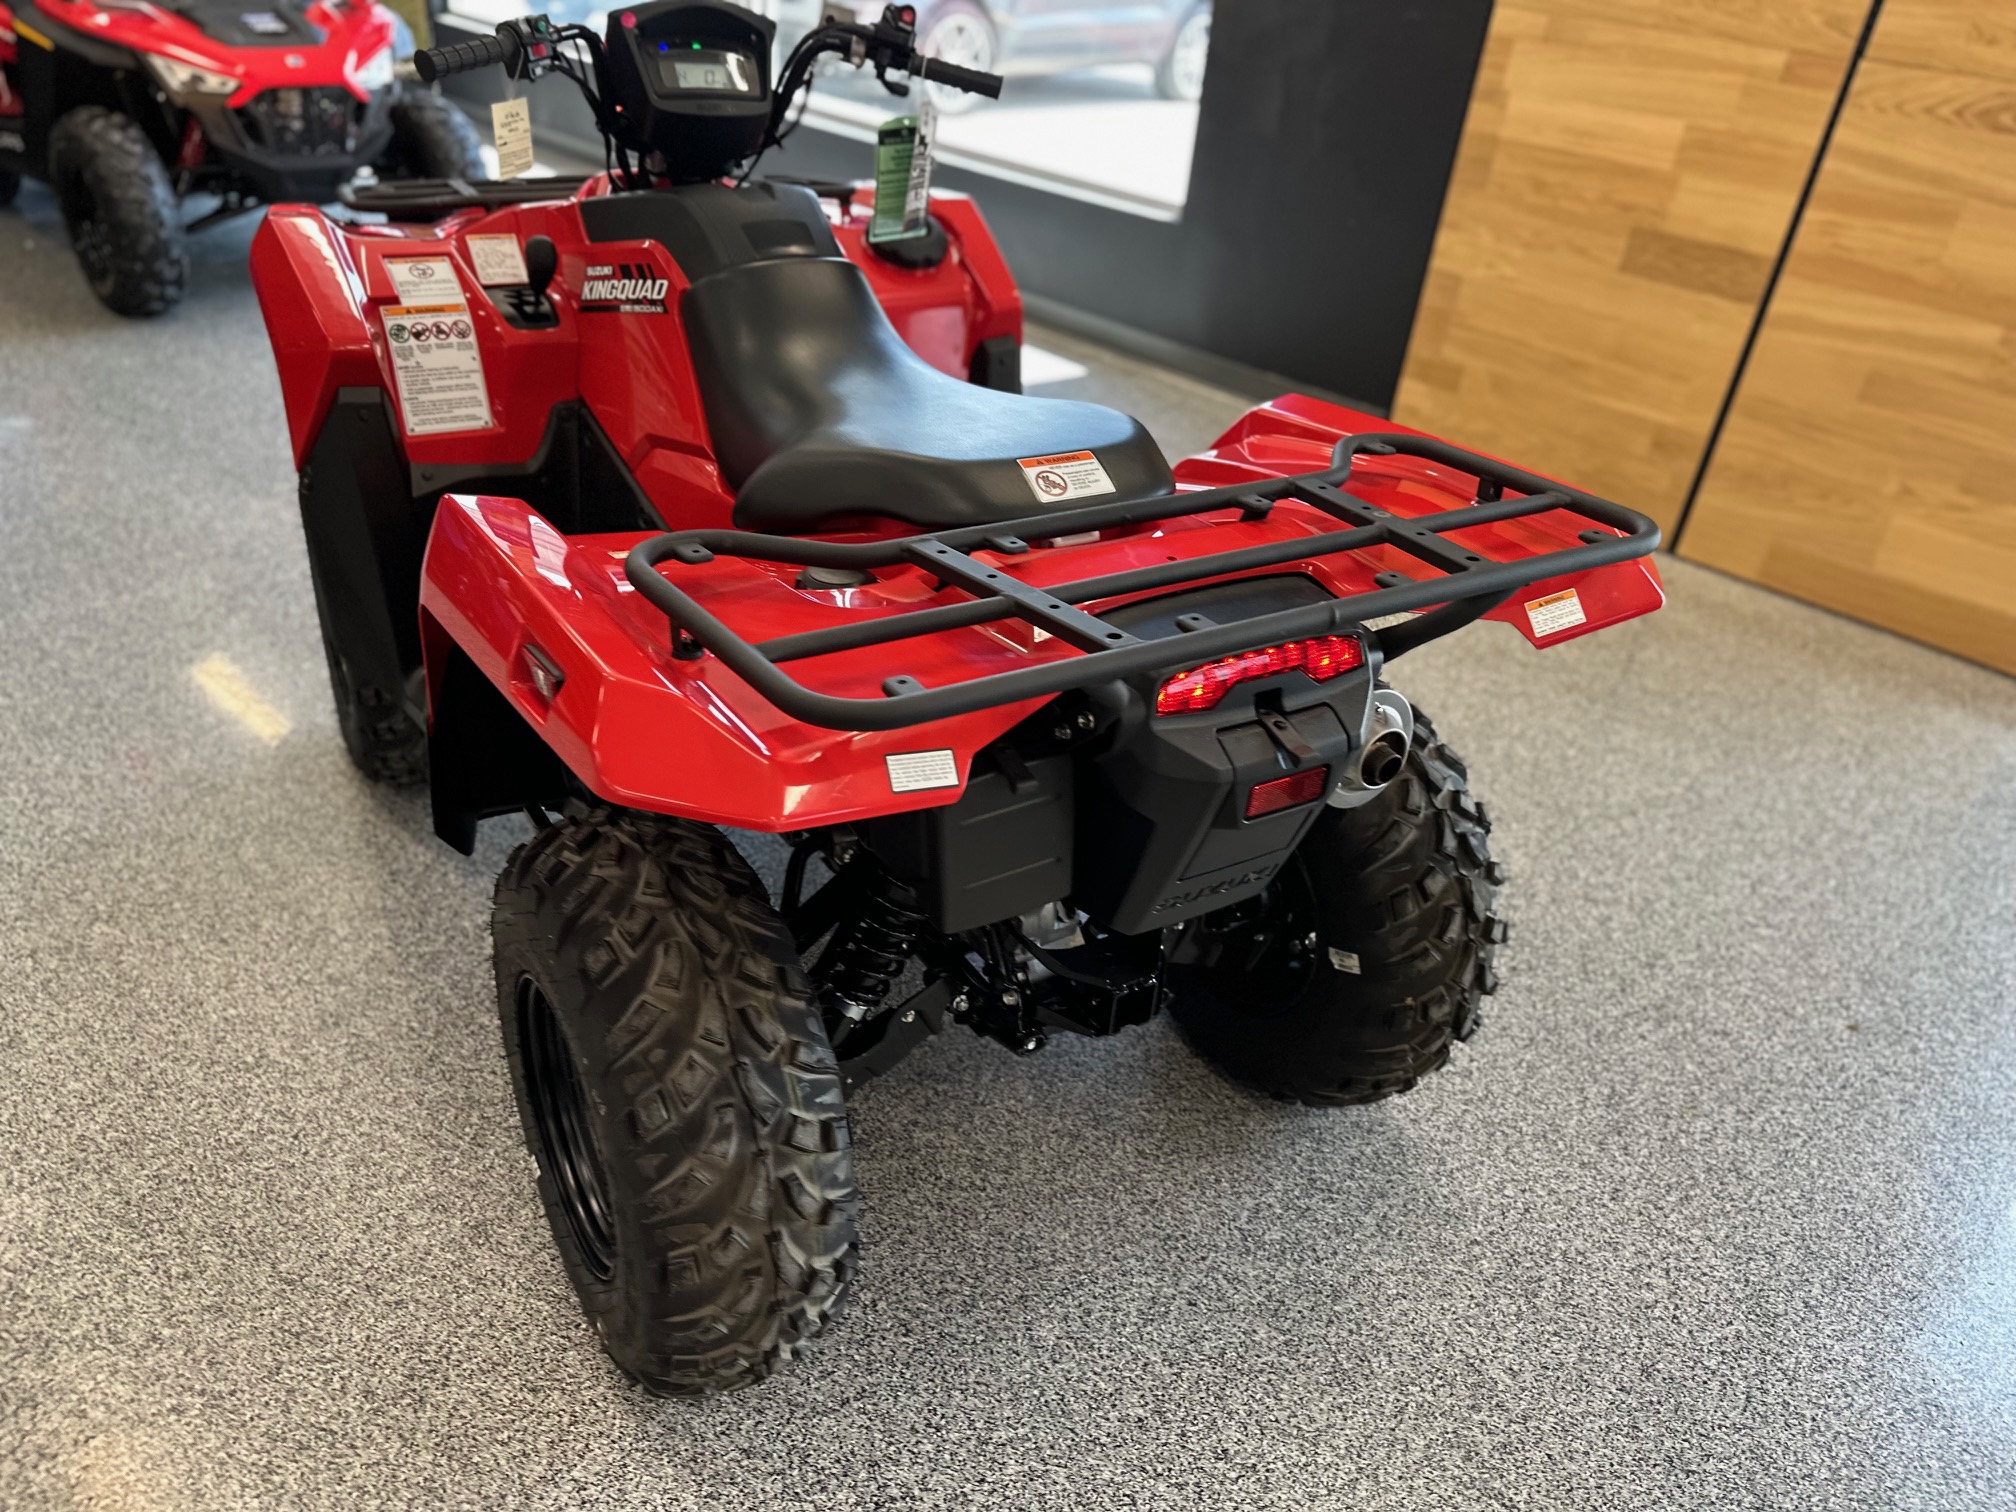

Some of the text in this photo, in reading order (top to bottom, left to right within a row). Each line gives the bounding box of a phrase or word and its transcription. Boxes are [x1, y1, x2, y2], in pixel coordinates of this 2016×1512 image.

[586, 265, 613, 276] SUZUKI
[581, 279, 669, 300] KINGQUAD
[1045, 454, 1080, 464] WARNING
